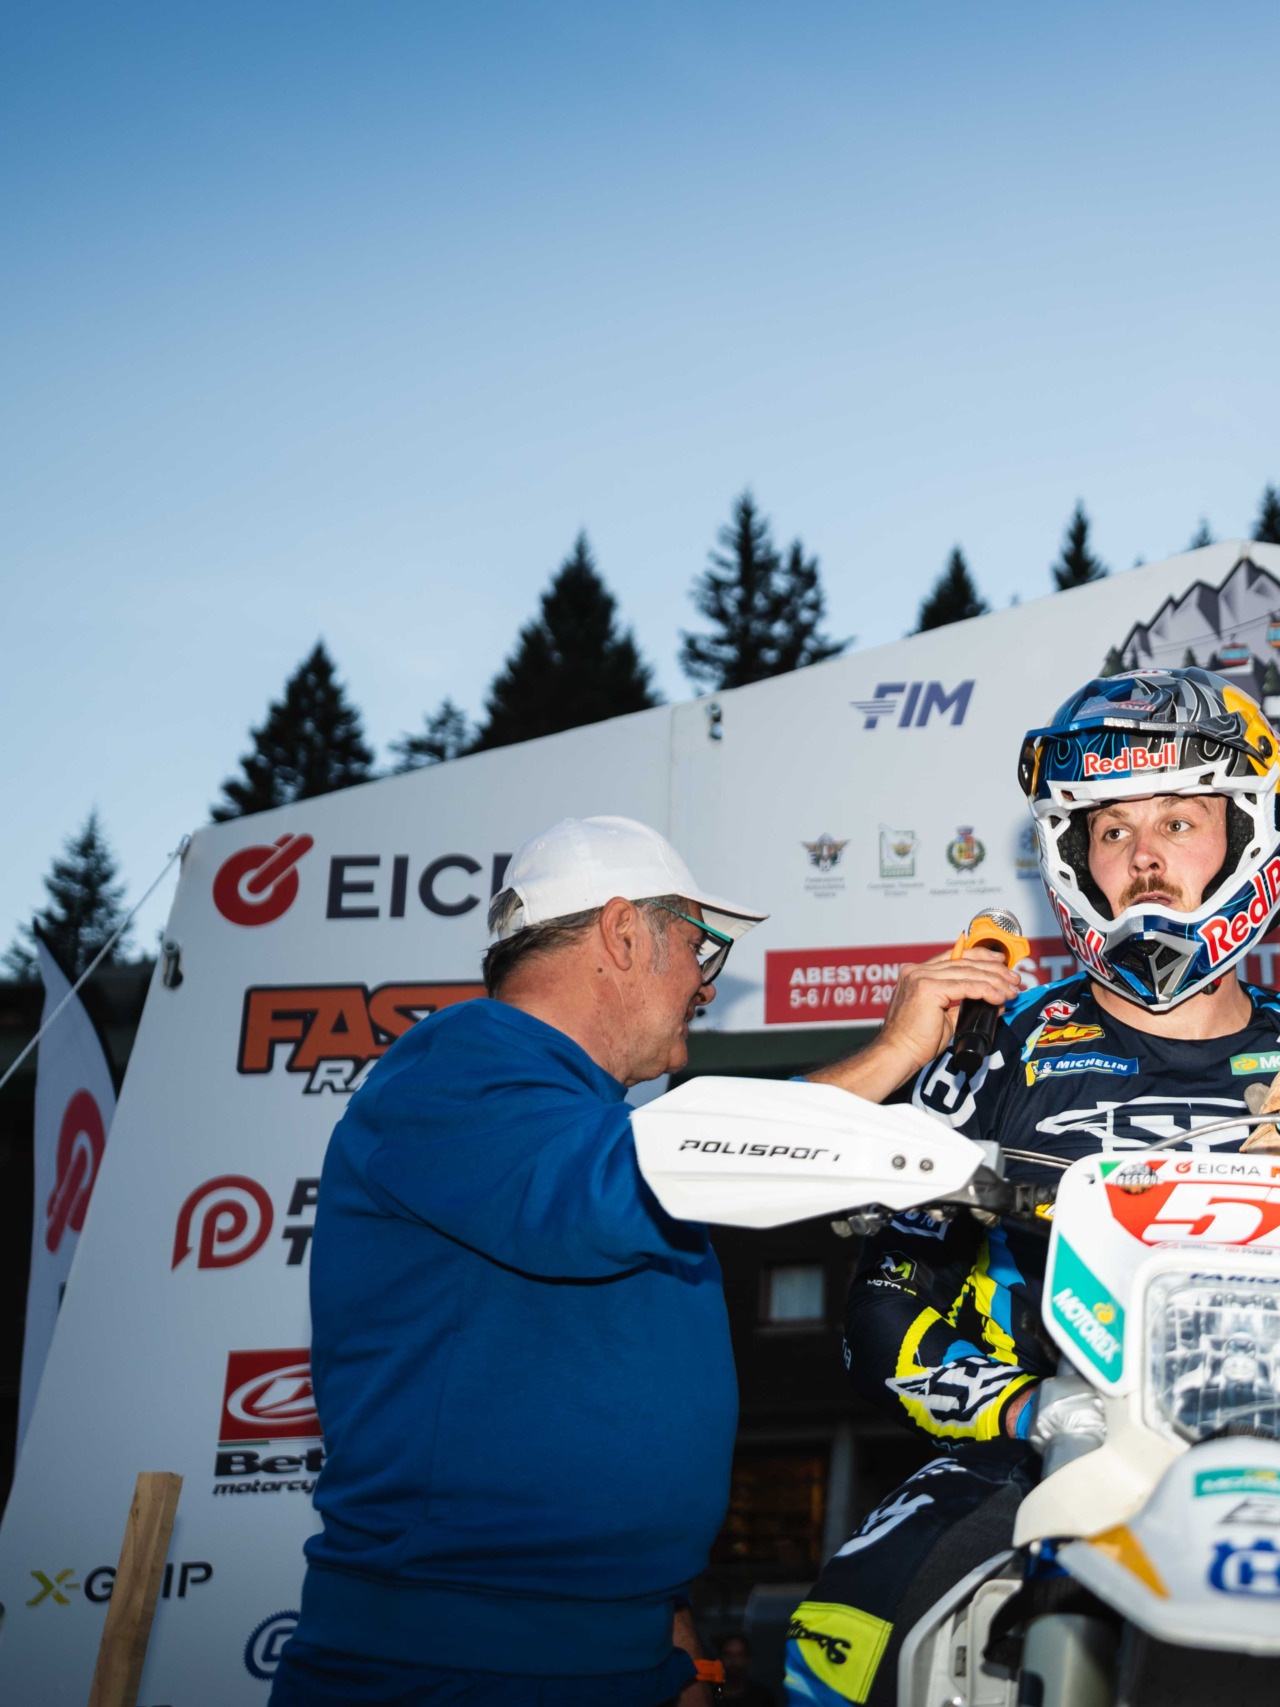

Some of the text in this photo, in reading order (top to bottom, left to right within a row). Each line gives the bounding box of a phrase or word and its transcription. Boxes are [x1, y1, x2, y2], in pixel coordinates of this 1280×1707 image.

[850, 679, 976, 729] FIM
[1083, 742, 1177, 776] Red Bull
[327, 853, 512, 918] EIC
[1198, 870, 1270, 967] Red
[790, 964, 907, 985] ABESTON
[791, 988, 818, 1008] 5-6
[834, 985, 857, 1005] 09
[238, 982, 487, 1075] FAS
[1056, 1057, 1128, 1072] MICHELIN
[1197, 1163, 1261, 1176] EICMA
[1051, 1287, 1123, 1364] MOTOREX
[214, 1447, 327, 1477] Bet
[211, 1478, 318, 1497] motorcy
[26, 1560, 213, 1607] X-GIP
